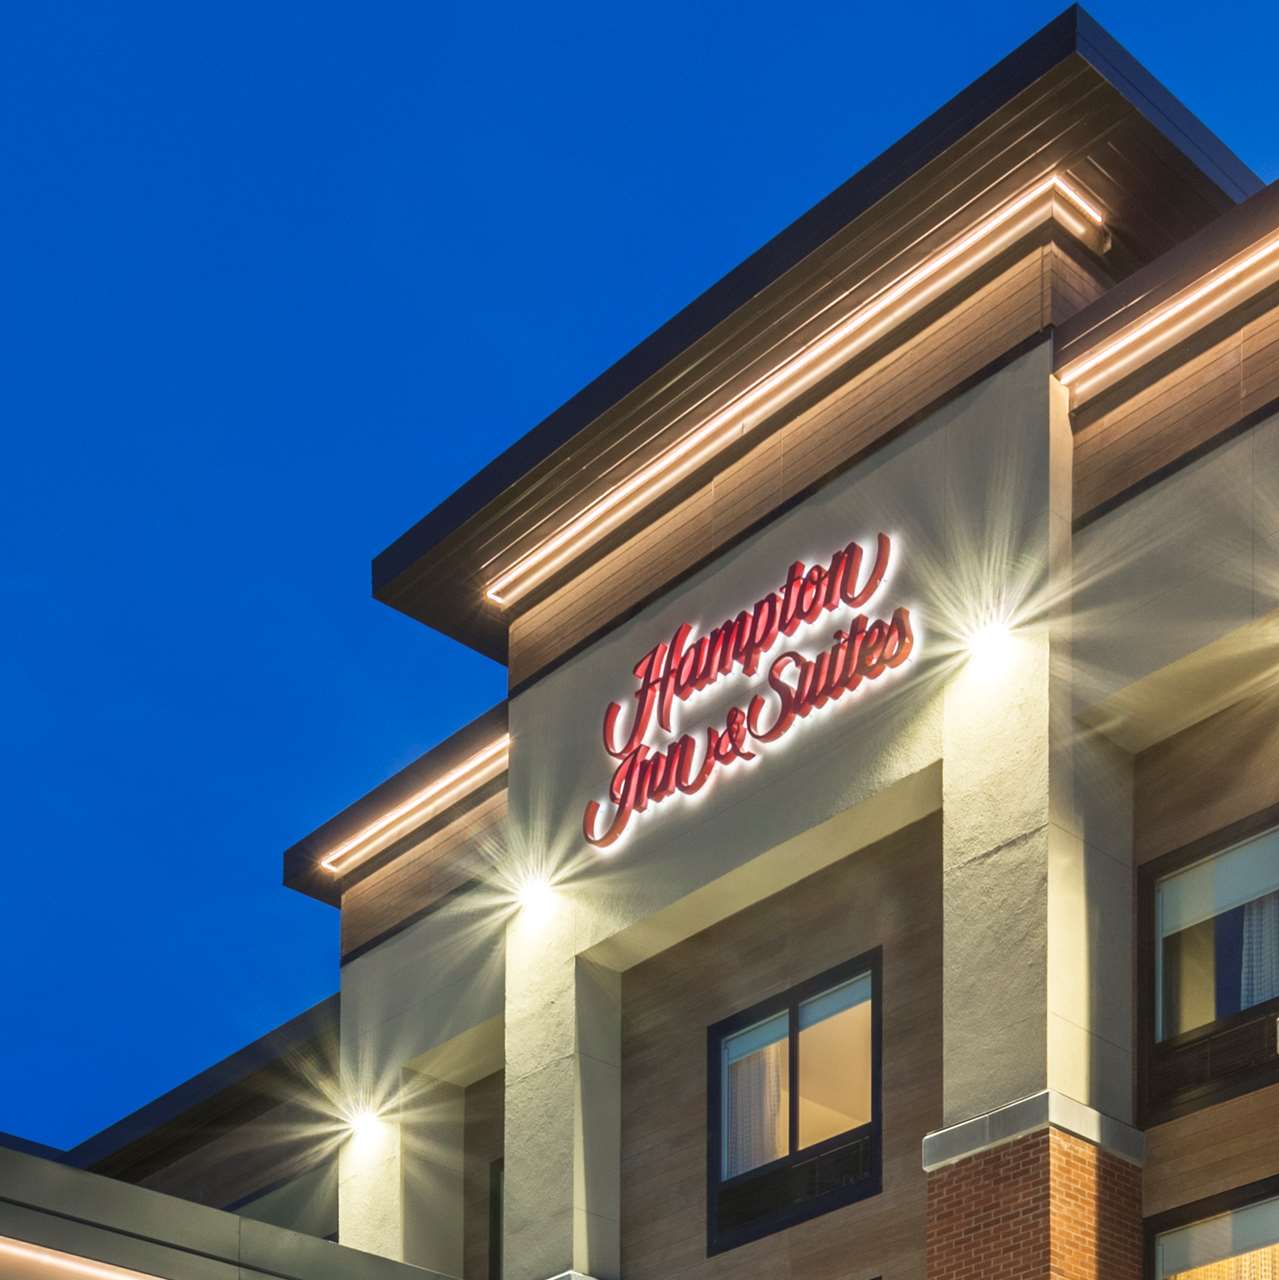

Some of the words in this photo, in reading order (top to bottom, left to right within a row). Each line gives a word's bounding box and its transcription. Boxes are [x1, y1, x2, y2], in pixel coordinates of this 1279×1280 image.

[583, 728, 719, 848] Inn
[717, 706, 756, 766] &
[747, 607, 914, 743] Suites
[604, 532, 891, 757] Hampton
